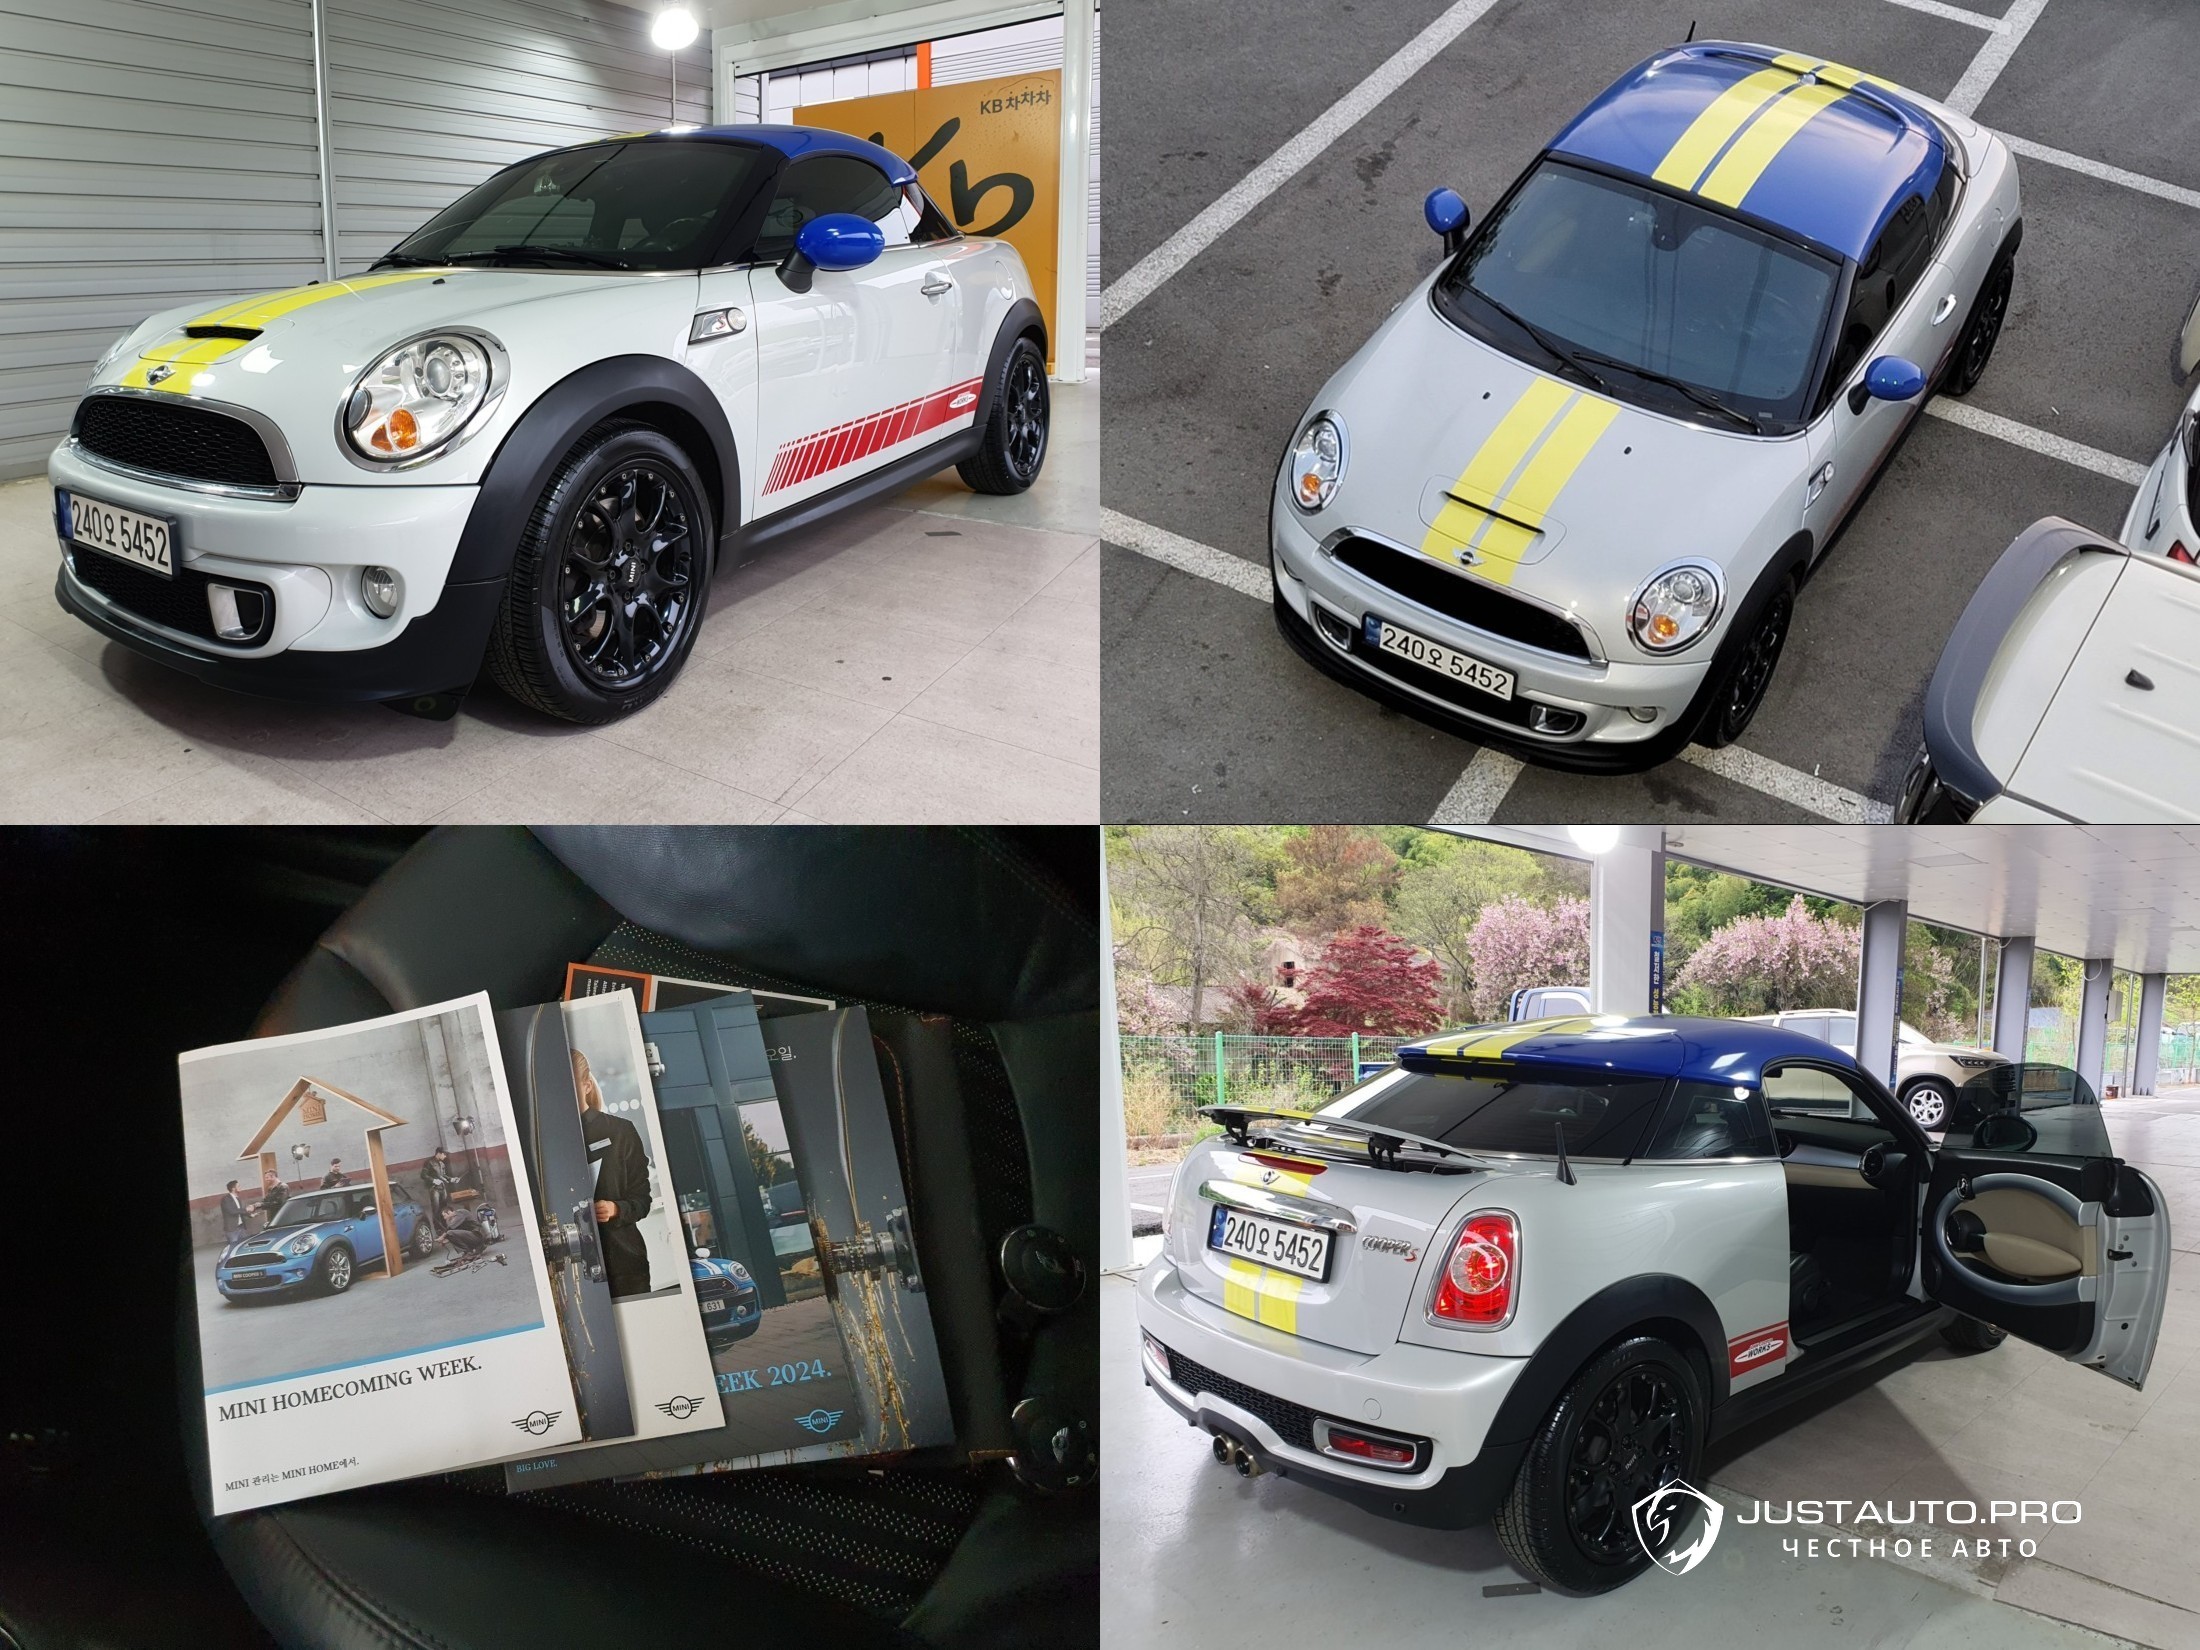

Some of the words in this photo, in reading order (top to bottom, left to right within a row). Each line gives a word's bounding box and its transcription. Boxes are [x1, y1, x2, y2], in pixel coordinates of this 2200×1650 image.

[980, 98, 1003, 115] KB
[1005, 85, 1052, 111] 차차차
[72, 500, 117, 547] 240오
[120, 515, 169, 567] 5452
[628, 561, 637, 583] MINI
[1382, 627, 1443, 669] 240오
[1449, 655, 1507, 695] 5452
[1224, 1216, 1270, 1257] 240오
[1273, 1229, 1324, 1273] 5452
[1362, 1235, 1411, 1256] COOPER
[1403, 1248, 1419, 1262] S
[1747, 1343, 1771, 1358] WORKS
[767, 1358, 832, 1387] 2024.
[218, 1398, 269, 1422] MINI
[271, 1370, 413, 1412] HOMECOMING
[416, 1355, 483, 1383] WEEK.
[672, 1402, 690, 1412] MINI
[811, 1416, 830, 1426] MINI
[529, 1418, 547, 1428] MINI
[225, 1478, 249, 1492] MINI
[251, 1473, 280, 1487] 관리는
[281, 1467, 307, 1481] MINI
[308, 1456, 360, 1475] HOME에서.
[516, 1463, 532, 1473] BIG
[533, 1459, 558, 1471] LOVE.
